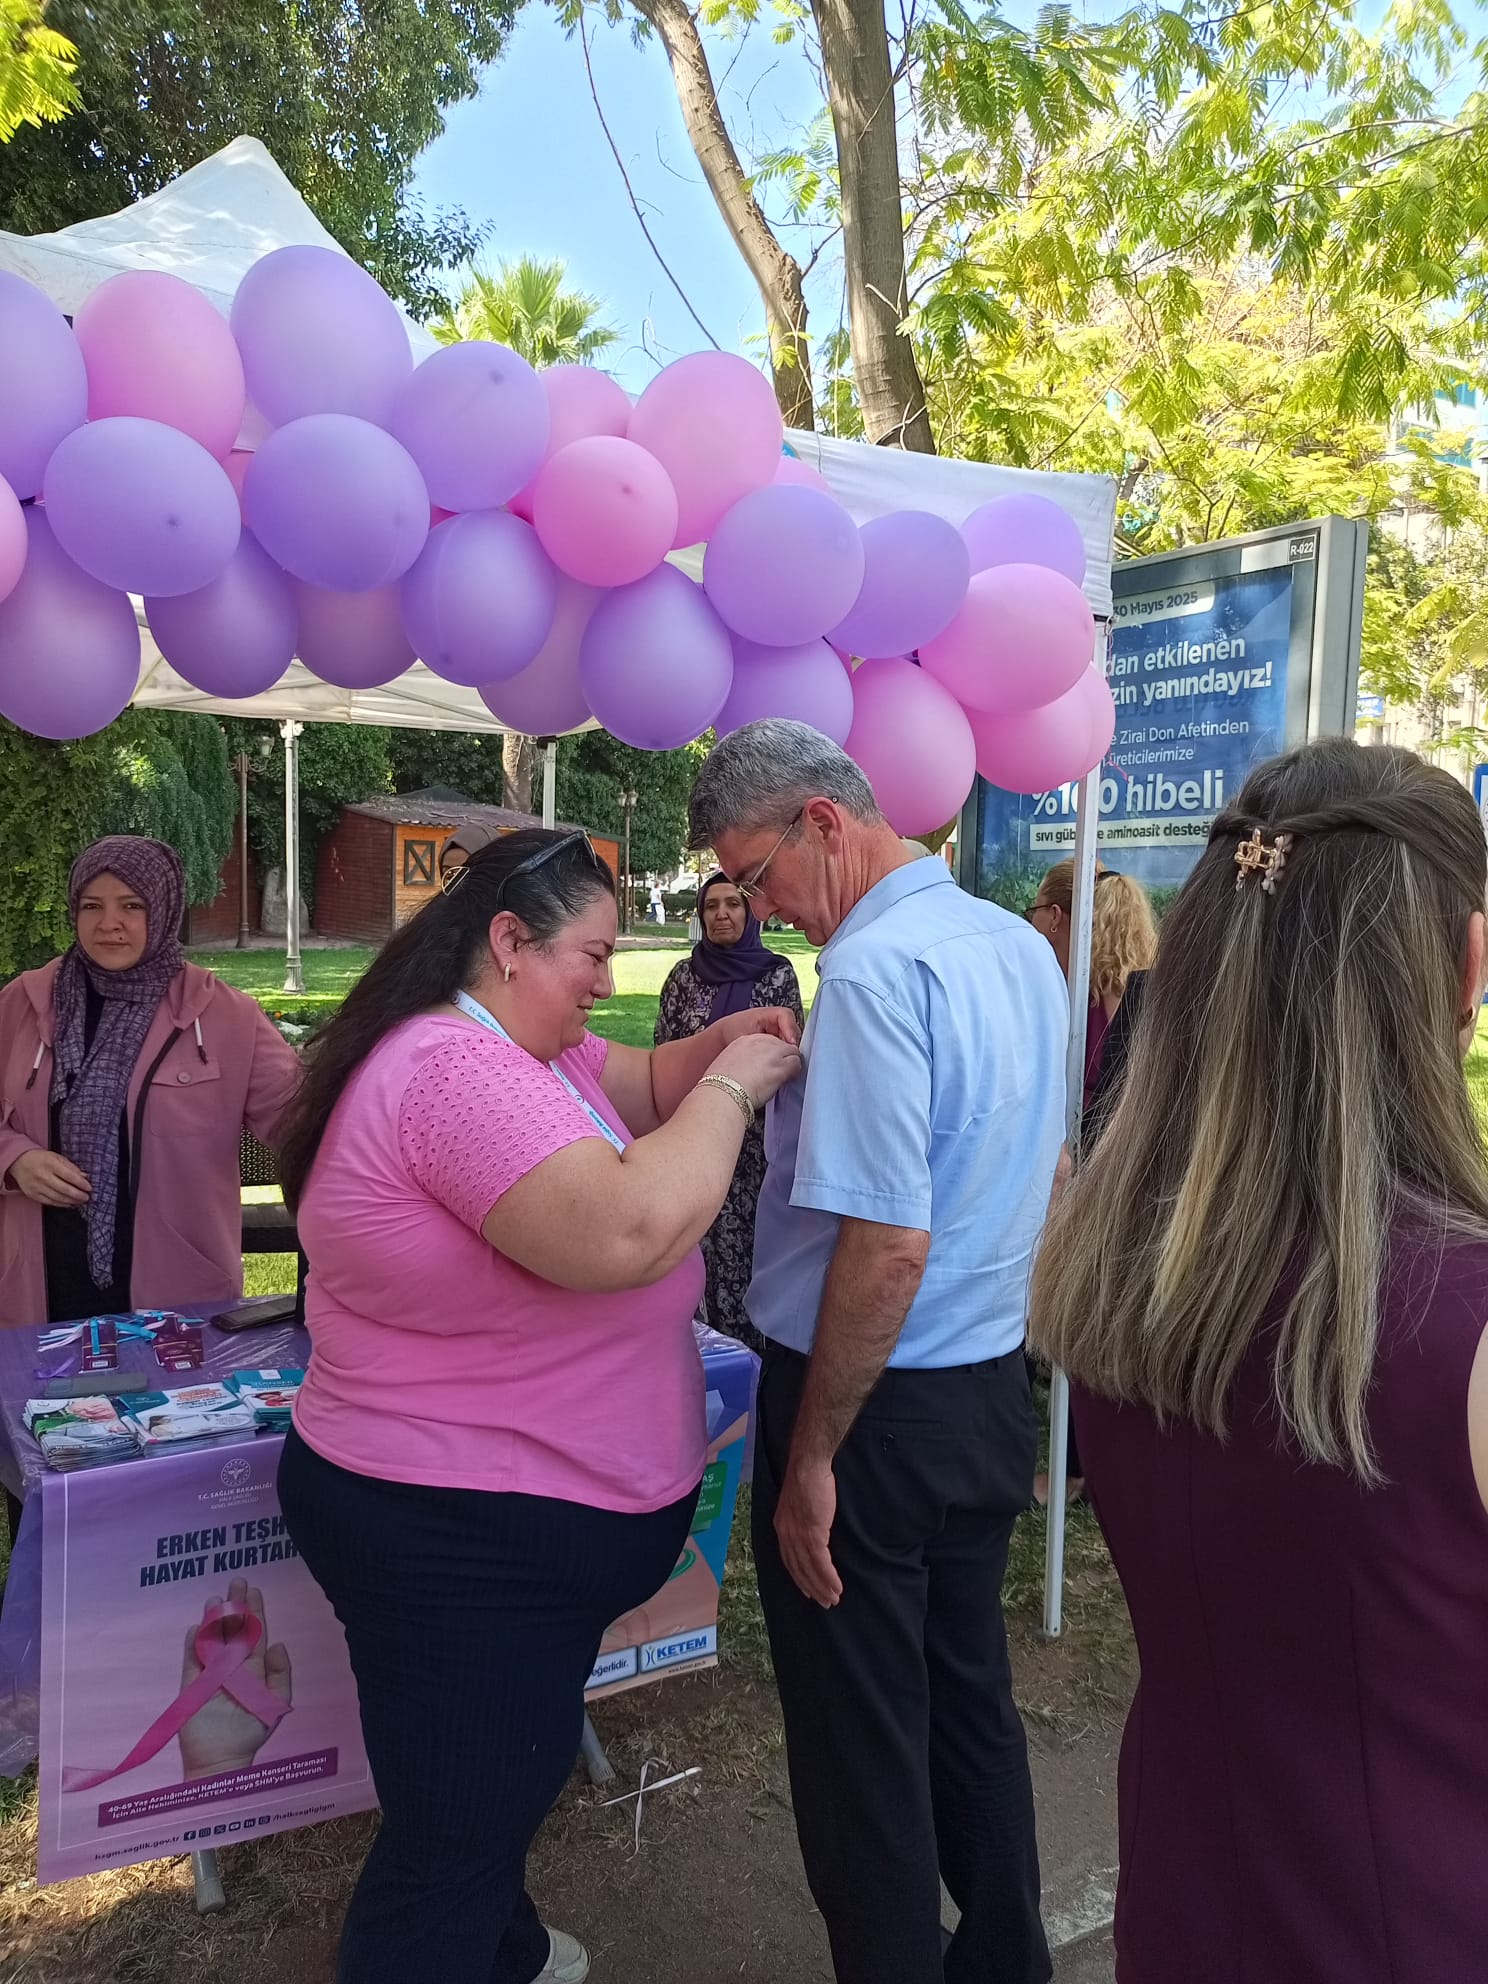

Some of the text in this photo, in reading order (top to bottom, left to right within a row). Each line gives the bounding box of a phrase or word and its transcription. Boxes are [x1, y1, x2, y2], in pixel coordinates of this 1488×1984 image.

[1290, 540, 1314, 556] R-022
[1130, 599, 1164, 616] Mayıs
[1167, 590, 1199, 609] 2025
[1143, 637, 1246, 672] etkilenen
[1142, 661, 1273, 706] yanındayız!
[1120, 728, 1146, 745] Zirai
[1149, 725, 1176, 742] Don
[1178, 719, 1250, 738] Afetinden
[1126, 768, 1224, 813] hibeli
[1055, 828, 1077, 843] güb
[1106, 822, 1161, 840] aminoasit
[1163, 820, 1212, 838] desteğ
[156, 1515, 289, 1560] ERKEN TEŞH
[140, 1555, 209, 1588] HAYAT
[656, 1635, 707, 1658] KETEM
[200, 1777, 236, 1791] Kadınlar
[236, 1772, 261, 1784] Meme
[261, 1764, 292, 1777] Kanseri
[293, 1756, 327, 1769] Taraması
